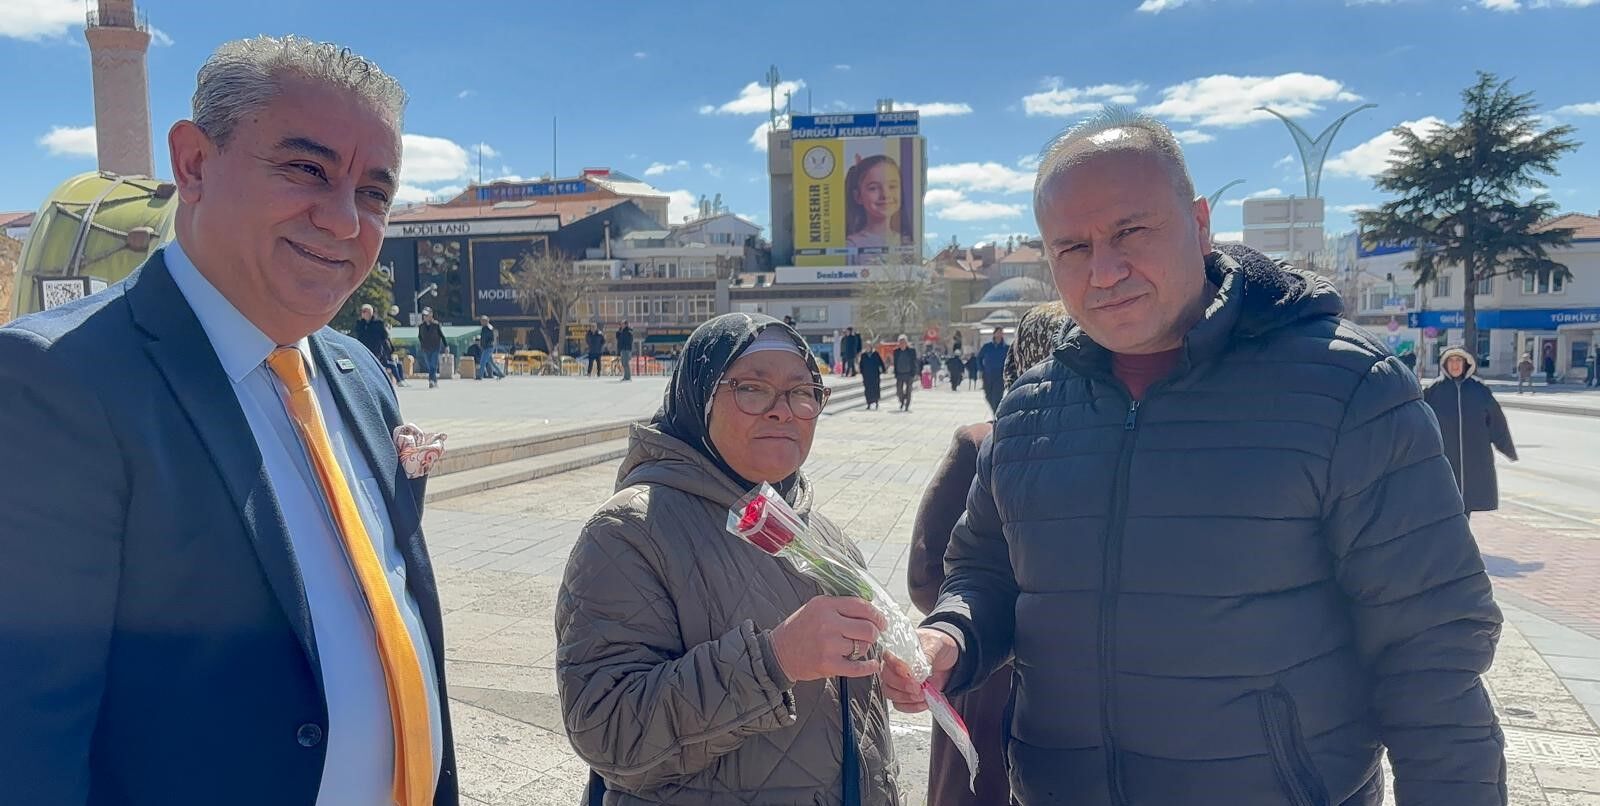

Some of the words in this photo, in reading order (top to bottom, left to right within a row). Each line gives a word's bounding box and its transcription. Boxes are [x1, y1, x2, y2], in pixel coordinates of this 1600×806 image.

[792, 126, 837, 138] SÜRÜCÜ
[839, 126, 877, 137] KURSU
[816, 271, 858, 279] DenizBank
[1551, 311, 1597, 322] TÜRKİYE
